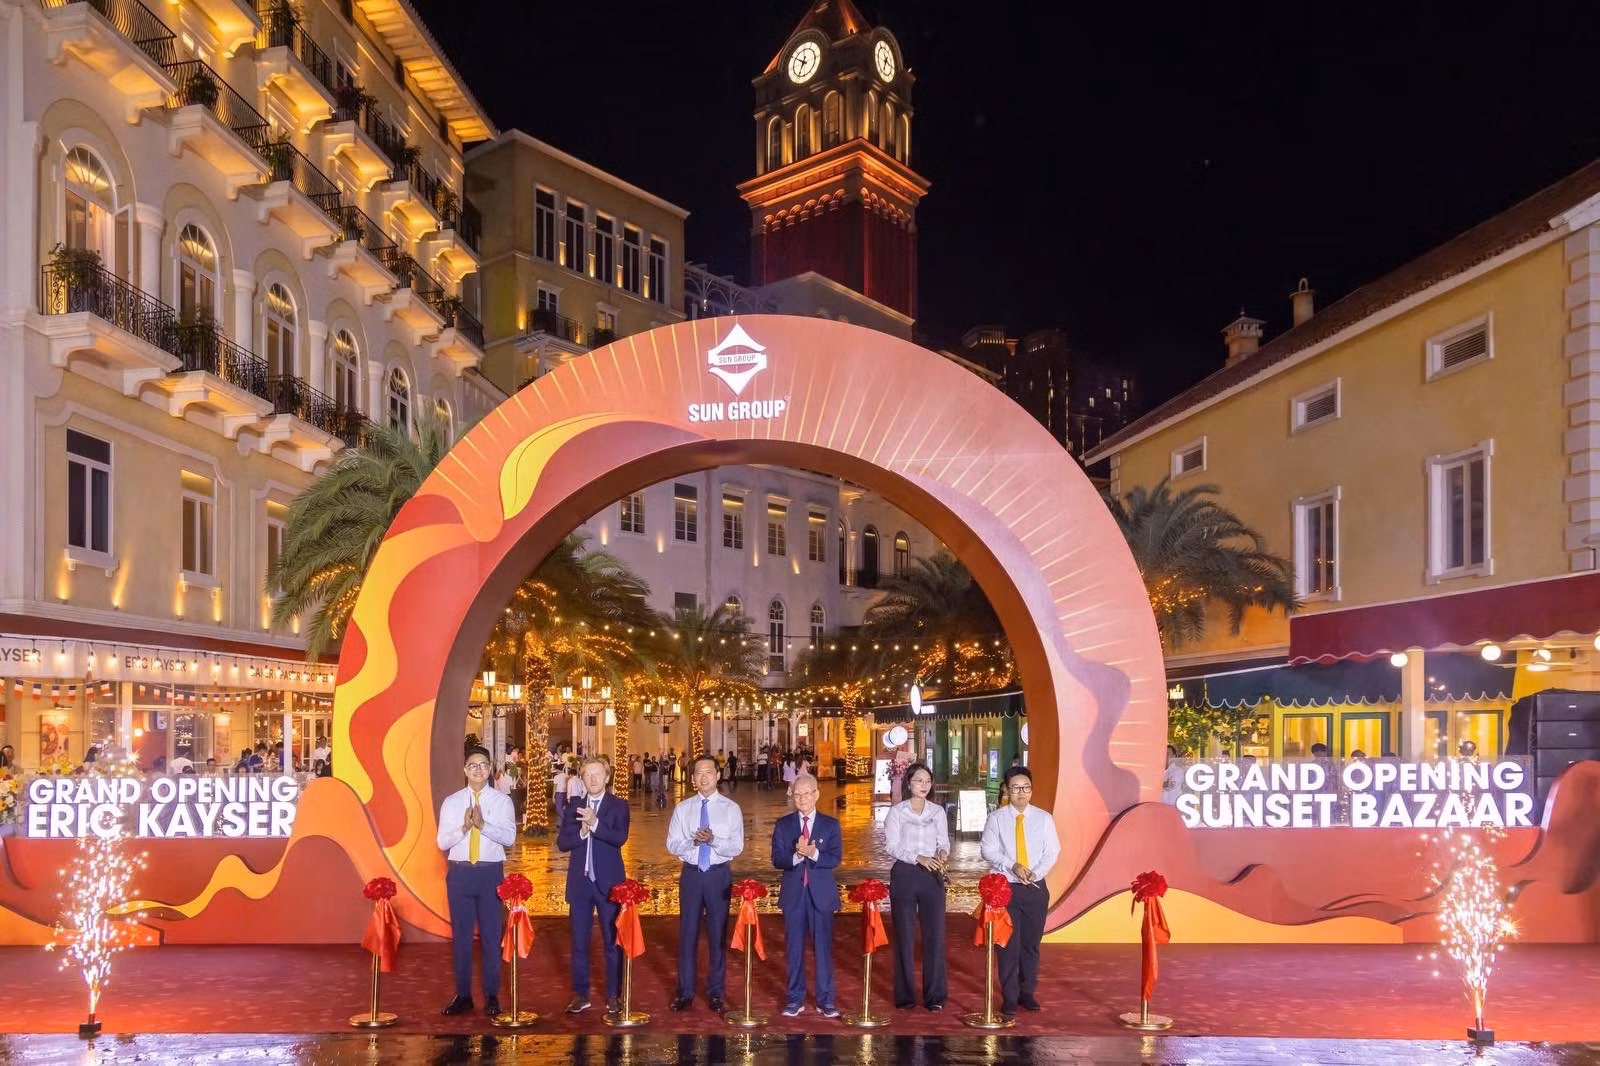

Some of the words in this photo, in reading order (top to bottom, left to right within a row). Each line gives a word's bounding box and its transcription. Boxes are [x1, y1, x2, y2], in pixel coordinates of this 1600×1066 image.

[718, 356, 732, 364] SUN
[733, 354, 756, 363] GROUP
[688, 403, 724, 423] SUN
[727, 400, 786, 421] GROUP
[0, 647, 42, 663] YSER
[125, 655, 148, 669] ERC
[1184, 763, 1326, 792] GRAND
[1342, 761, 1524, 791] OPENING
[29, 778, 141, 804] GRAND
[150, 776, 298, 804] OPENING
[28, 803, 123, 838] ERIC
[139, 801, 297, 837] KAYSER
[1176, 793, 1338, 828] SUNSET
[1352, 792, 1534, 828] BAZAAR
